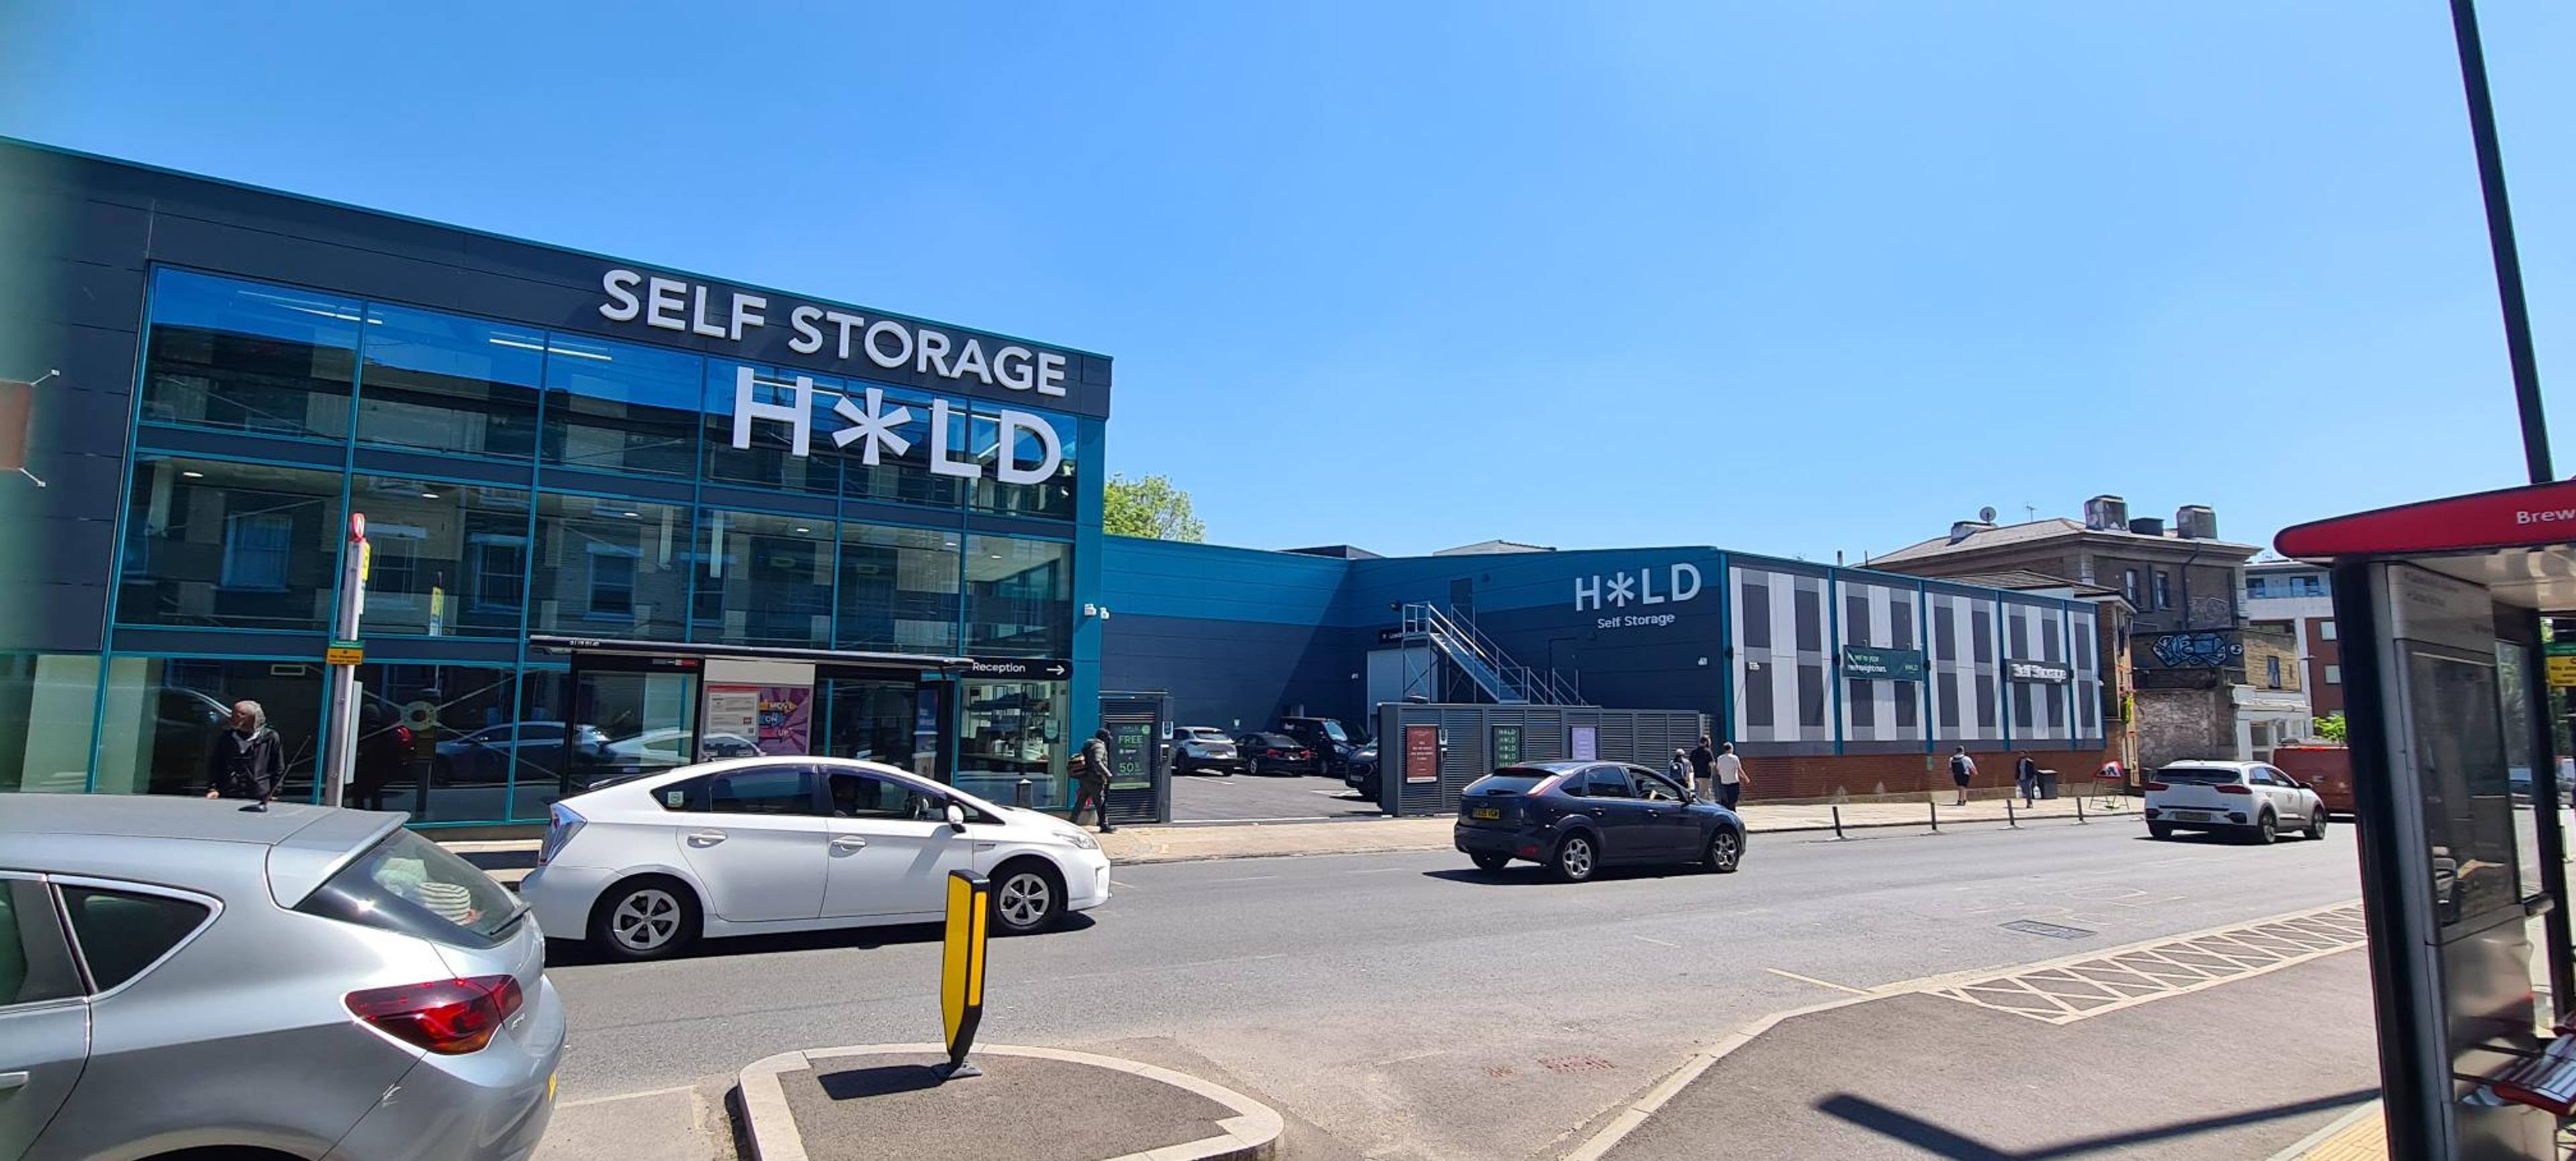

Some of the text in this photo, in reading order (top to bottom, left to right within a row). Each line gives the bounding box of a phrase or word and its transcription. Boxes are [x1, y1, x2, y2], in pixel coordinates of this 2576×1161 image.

[598, 269, 1067, 397] SELF STORAGE
[2516, 509, 2576, 524] Brew
[1597, 613, 1676, 629] Self Storage
[972, 662, 1026, 674] Reception
[765, 715, 777, 723] ON
[1118, 735, 1143, 744] FREE
